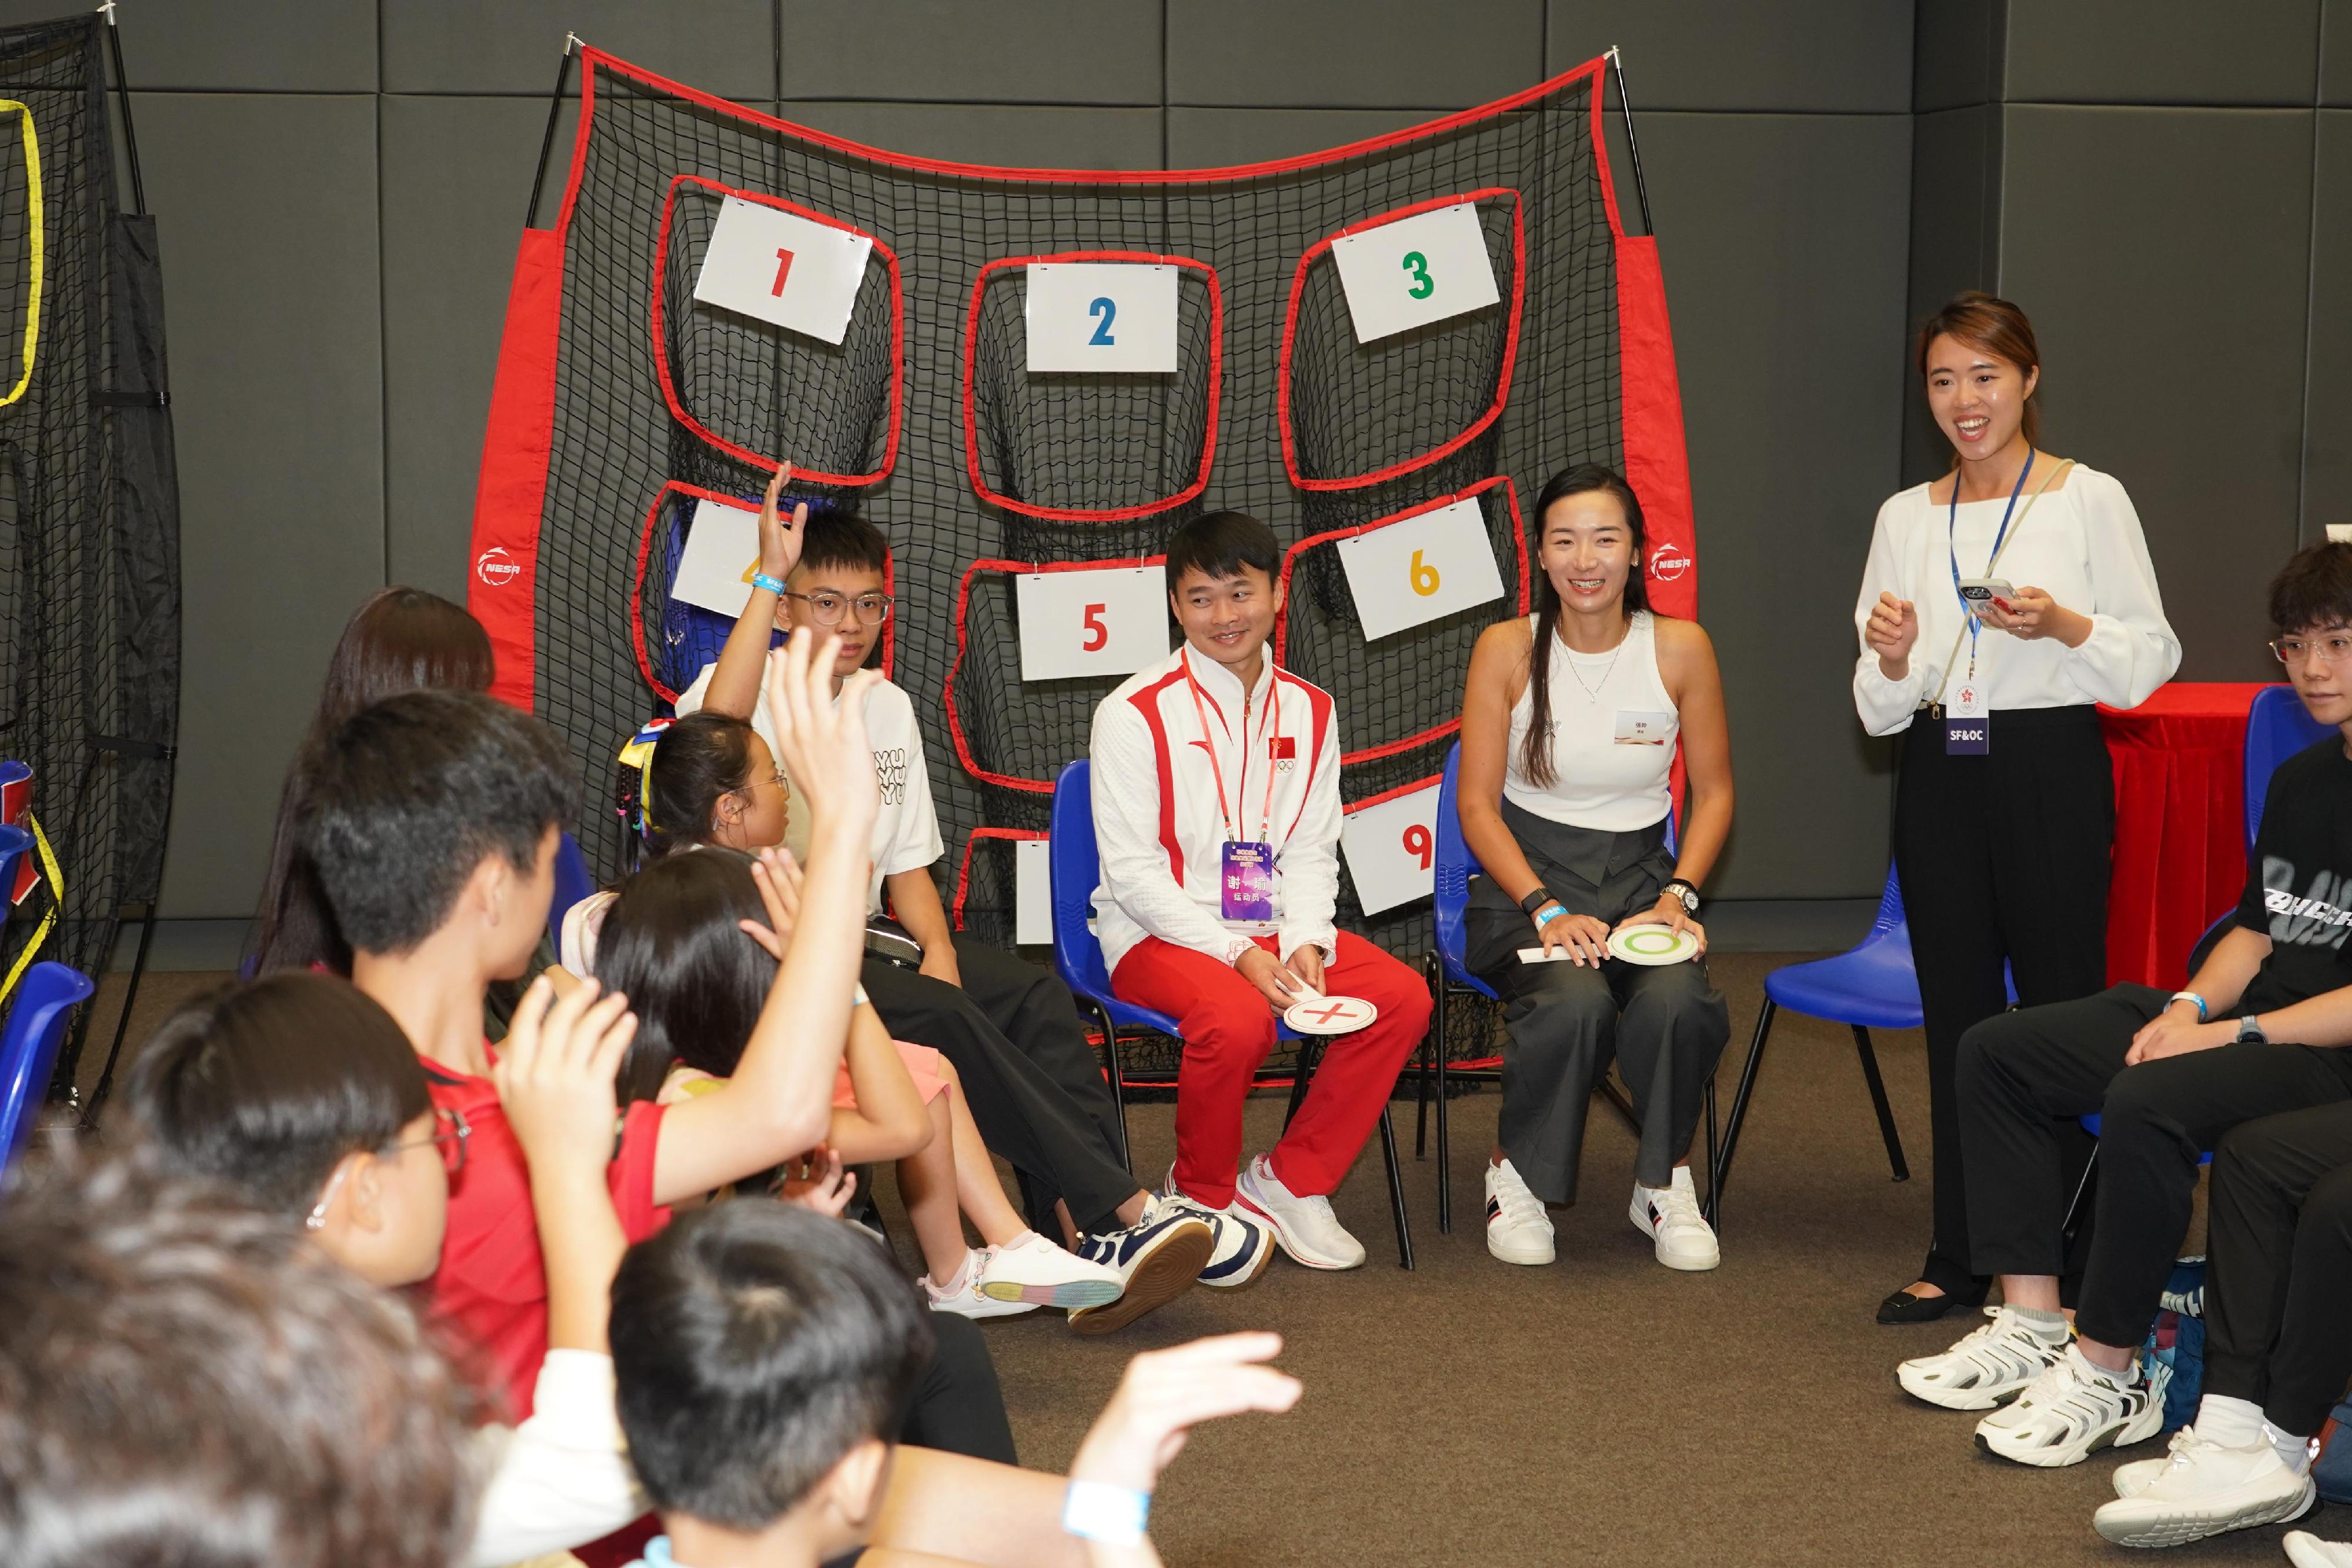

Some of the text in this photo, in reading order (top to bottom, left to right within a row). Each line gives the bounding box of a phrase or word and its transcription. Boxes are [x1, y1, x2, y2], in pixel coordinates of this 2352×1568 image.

[771, 248, 794, 297] 1
[1402, 252, 1434, 300] 3
[1089, 297, 1115, 346] 2
[486, 563, 520, 574] NESA
[1410, 549, 1441, 597] 6
[1659, 559, 1691, 569] NESA
[1083, 603, 1108, 652] 5
[1950, 729, 1983, 741] SF&OC
[1402, 824, 1432, 871] 9
[1234, 892, 1259, 902] 运动员
